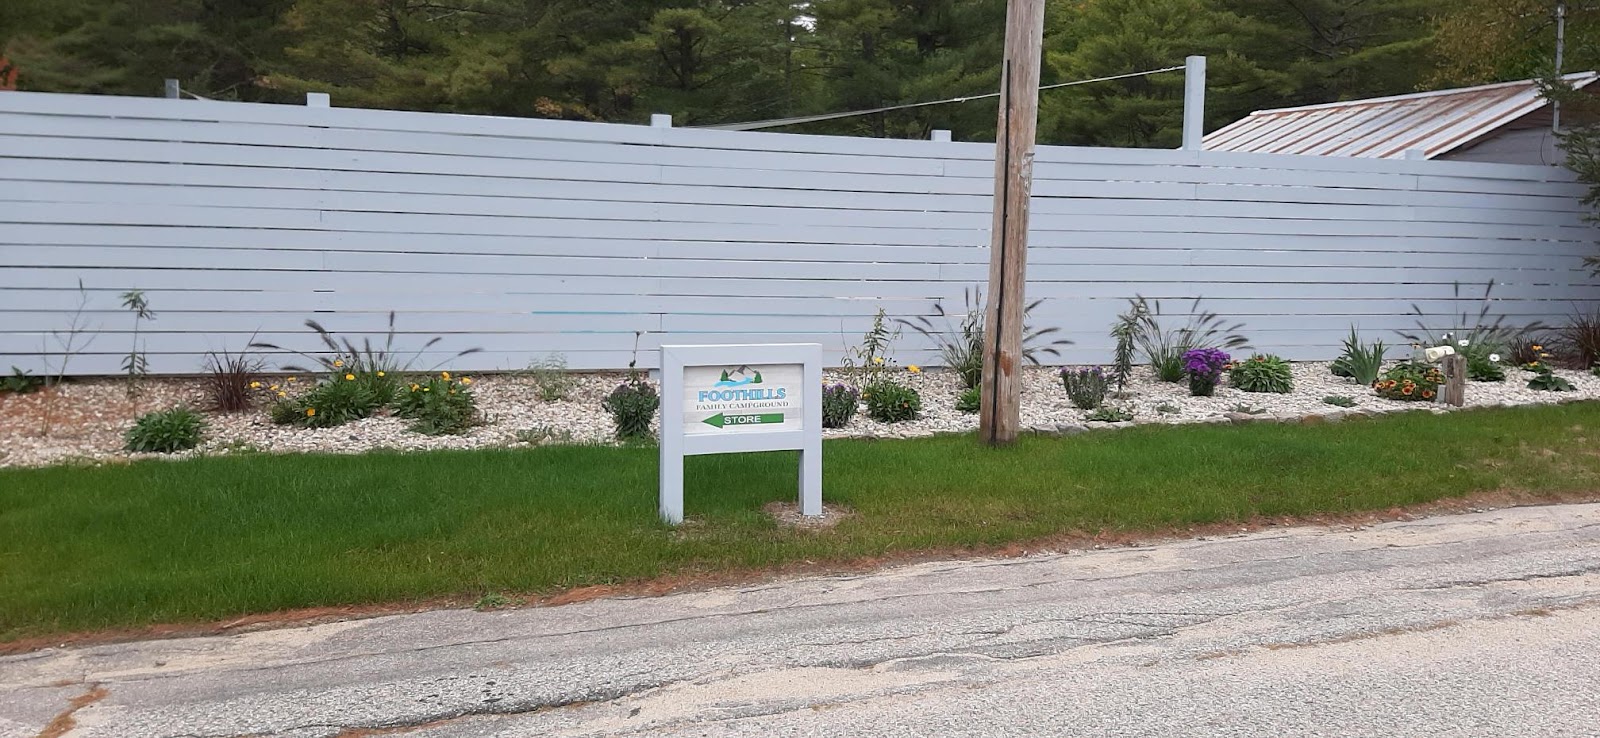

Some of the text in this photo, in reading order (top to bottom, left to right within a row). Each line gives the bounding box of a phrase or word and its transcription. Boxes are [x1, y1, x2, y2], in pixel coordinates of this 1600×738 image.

[698, 388, 786, 402] FOOTHILLS
[696, 401, 789, 411] FAMILY CAMPGROUND
[724, 415, 761, 424] STORE
